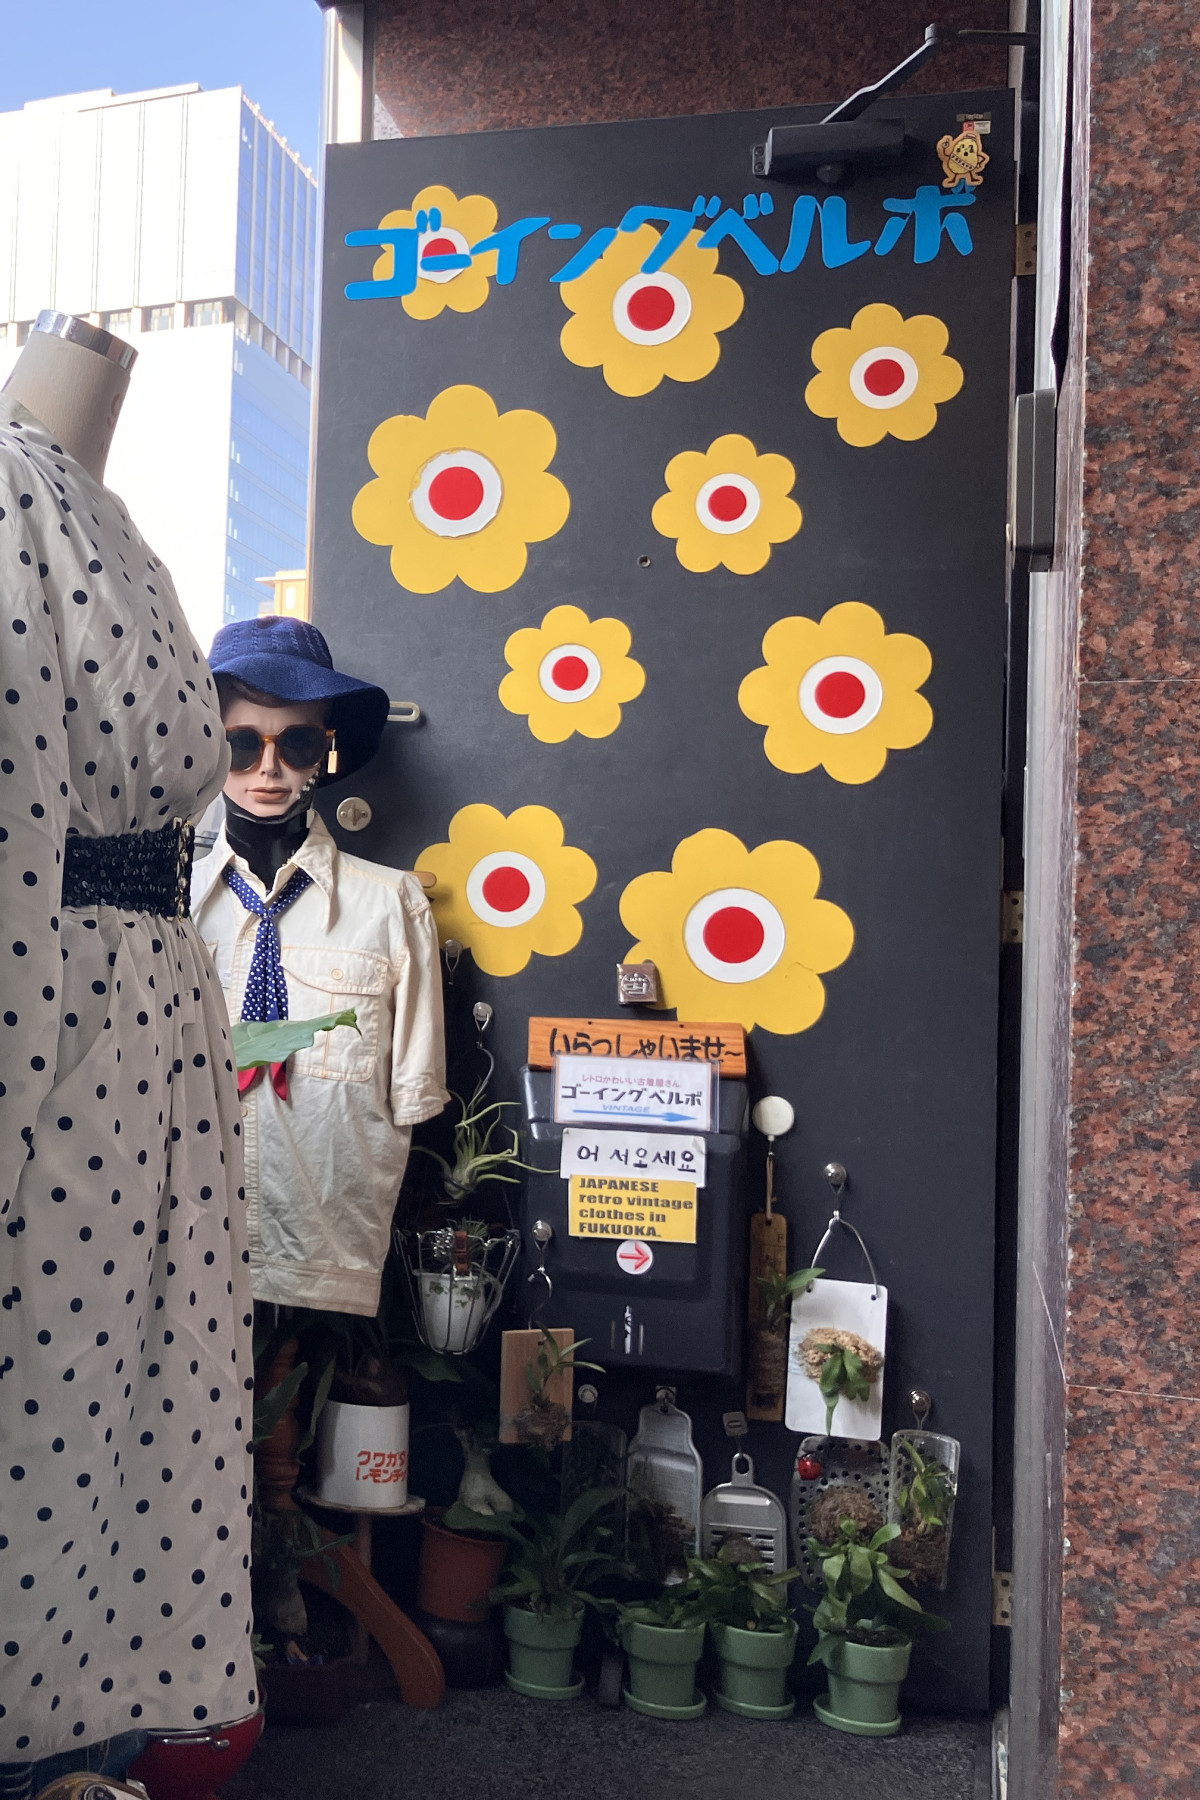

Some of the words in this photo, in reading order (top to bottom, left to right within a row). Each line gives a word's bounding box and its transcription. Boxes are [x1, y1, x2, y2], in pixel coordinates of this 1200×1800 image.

[581, 1073, 681, 1089] レトロかわいい古着屋さん
[561, 1083, 703, 1107] ゴーイングベルボ
[602, 1104, 650, 1114] VINTAGE
[578, 1178, 660, 1193] JAPANESE
[578, 1194, 623, 1205] retro
[627, 1196, 694, 1210] vintage
[578, 1208, 645, 1221] clothes
[649, 1211, 667, 1223] in
